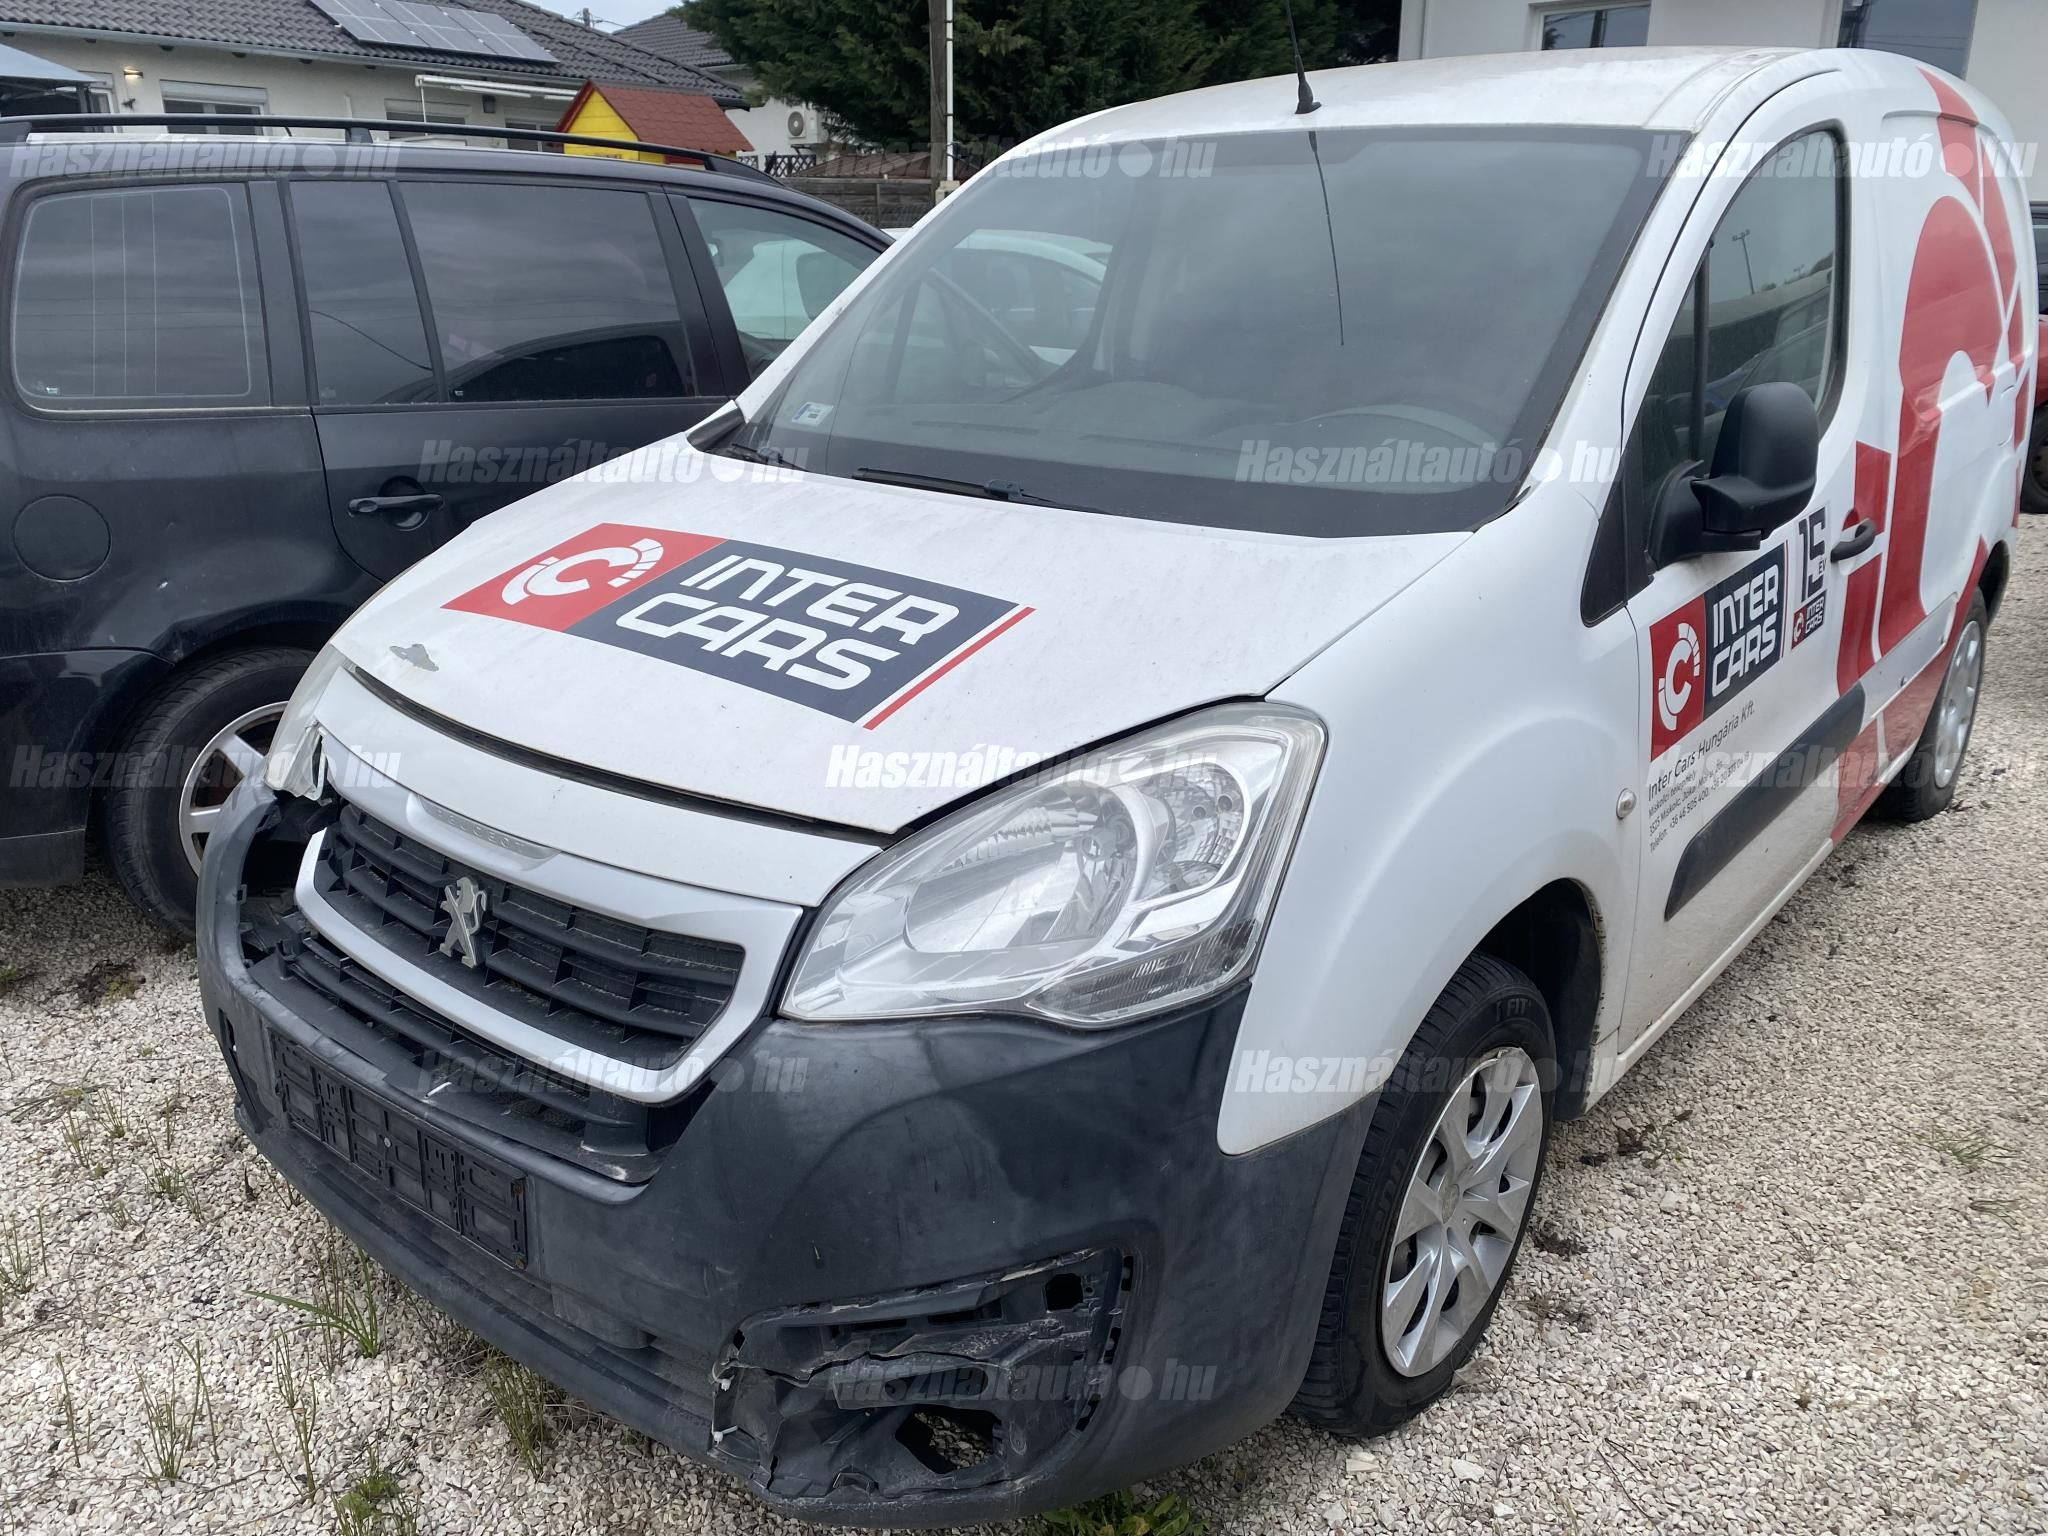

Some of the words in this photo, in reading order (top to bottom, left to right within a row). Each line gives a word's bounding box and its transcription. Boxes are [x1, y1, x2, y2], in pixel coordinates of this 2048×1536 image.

[1799, 507, 1825, 602] 15
[616, 592, 901, 690] CARS
[680, 554, 959, 645] INTER
[1713, 564, 1779, 647] INTER
[1805, 611, 1823, 634] CARS
[1806, 596, 1825, 619] INTER
[1712, 611, 1778, 697] CARS
[1648, 770, 1673, 801] Inter
[1674, 751, 1696, 778] Cars
[1698, 714, 1739, 759] Hungária
